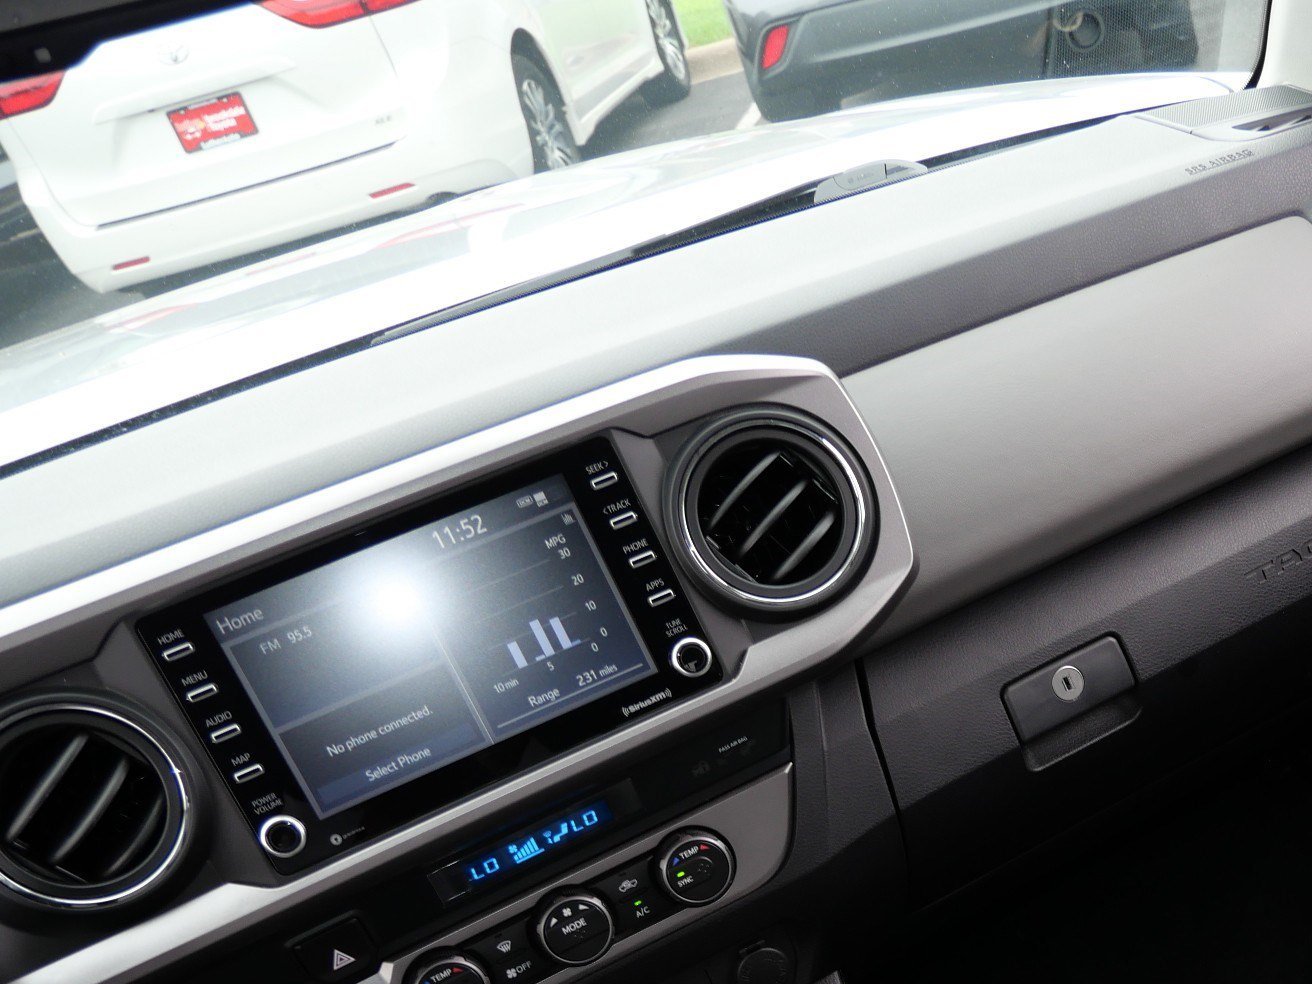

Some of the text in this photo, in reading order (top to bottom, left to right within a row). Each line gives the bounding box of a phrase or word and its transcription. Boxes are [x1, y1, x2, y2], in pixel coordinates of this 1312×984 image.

[1208, 149, 1255, 167] AIRBAG
[585, 462, 604, 475] SEEK
[606, 499, 632, 513] TRACK
[432, 514, 488, 549] 11:52
[544, 533, 567, 550] MPG
[622, 538, 649, 555] PHONE
[558, 547, 571, 560] 30
[571, 573, 585, 586] 20
[645, 577, 665, 592] APPS
[585, 600, 597, 612] 10
[216, 608, 265, 635] Home
[157, 628, 185, 646] HOME
[259, 624, 313, 655] FM 95.5
[600, 627, 608, 637] 0
[590, 642, 599, 653] 0
[546, 661, 555, 672] 5
[181, 670, 208, 687] MENU
[528, 662, 618, 707] Range 231 miles
[205, 710, 233, 728] AUDIO
[325, 704, 434, 757] No phone connected.
[231, 752, 251, 767] MAP
[365, 747, 432, 782] Select Phone
[251, 792, 277, 808] POWER
[253, 799, 283, 816] VOLUME
[570, 809, 599, 833] LO
[678, 845, 699, 860] TEMP
[470, 857, 500, 880] LO
[677, 875, 694, 888] SYNC
[635, 905, 651, 918] A/C
[561, 917, 588, 935] MODE
[516, 960, 533, 975] OFF
[430, 968, 452, 984] TEMP
